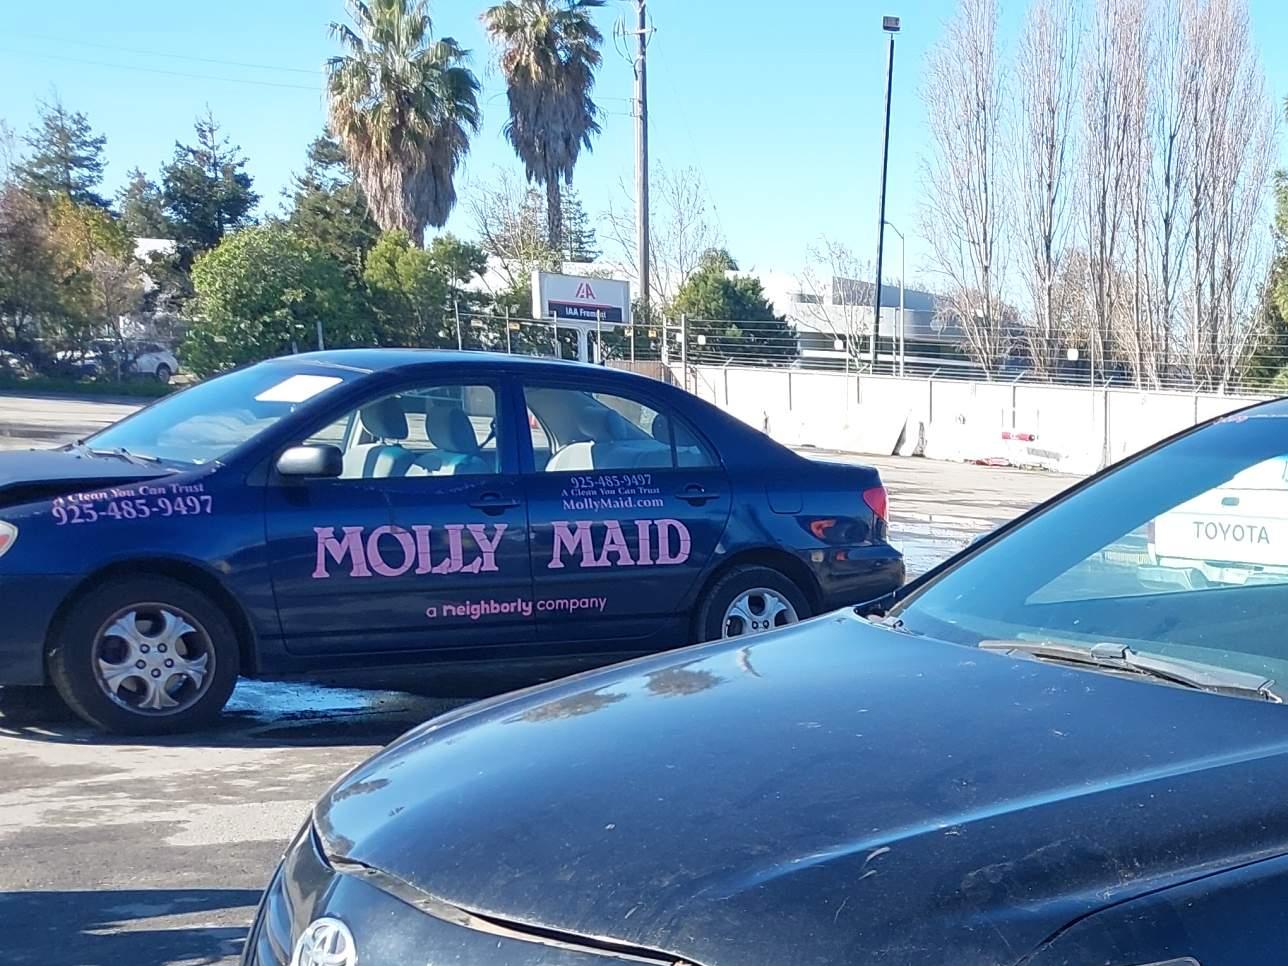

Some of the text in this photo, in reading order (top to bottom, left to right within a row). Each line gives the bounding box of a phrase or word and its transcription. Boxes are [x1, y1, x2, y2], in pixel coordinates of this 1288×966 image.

[565, 306, 607, 319] IAA Fremnt
[570, 474, 651, 488] 925-485-9497
[68, 491, 108, 502] Clean
[110, 488, 134, 498] You
[139, 485, 166, 495] Can
[169, 482, 204, 494] Trust
[561, 486, 660, 497] A Clean You Can Trust
[52, 495, 213, 525] 925-485-9497
[563, 497, 664, 512] MollyMaid.com
[1193, 521, 1270, 544] TOYOTA
[312, 518, 691, 578] MOLLY MAID
[425, 596, 607, 620] a neighborly company
